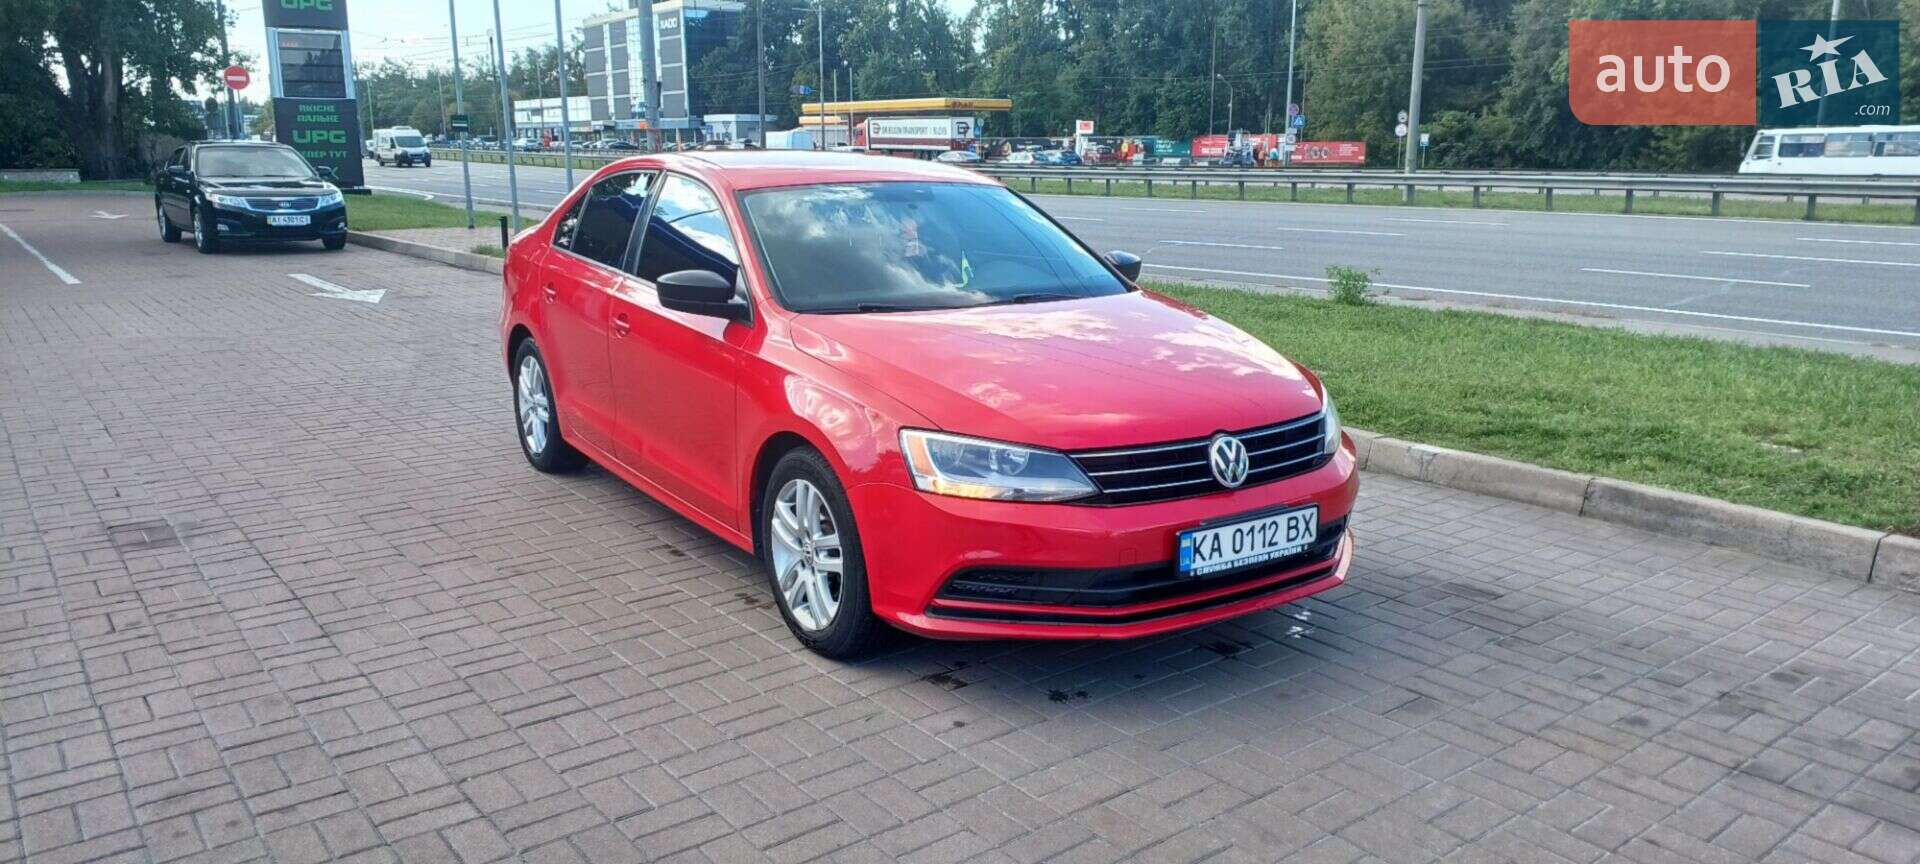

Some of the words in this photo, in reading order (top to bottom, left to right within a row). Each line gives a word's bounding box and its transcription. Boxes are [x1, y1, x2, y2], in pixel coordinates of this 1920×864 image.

[292, 129, 346, 144] UPG
[1193, 532, 1222, 564] KA
[1232, 520, 1278, 554] 0112
[1286, 512, 1315, 543] BX
